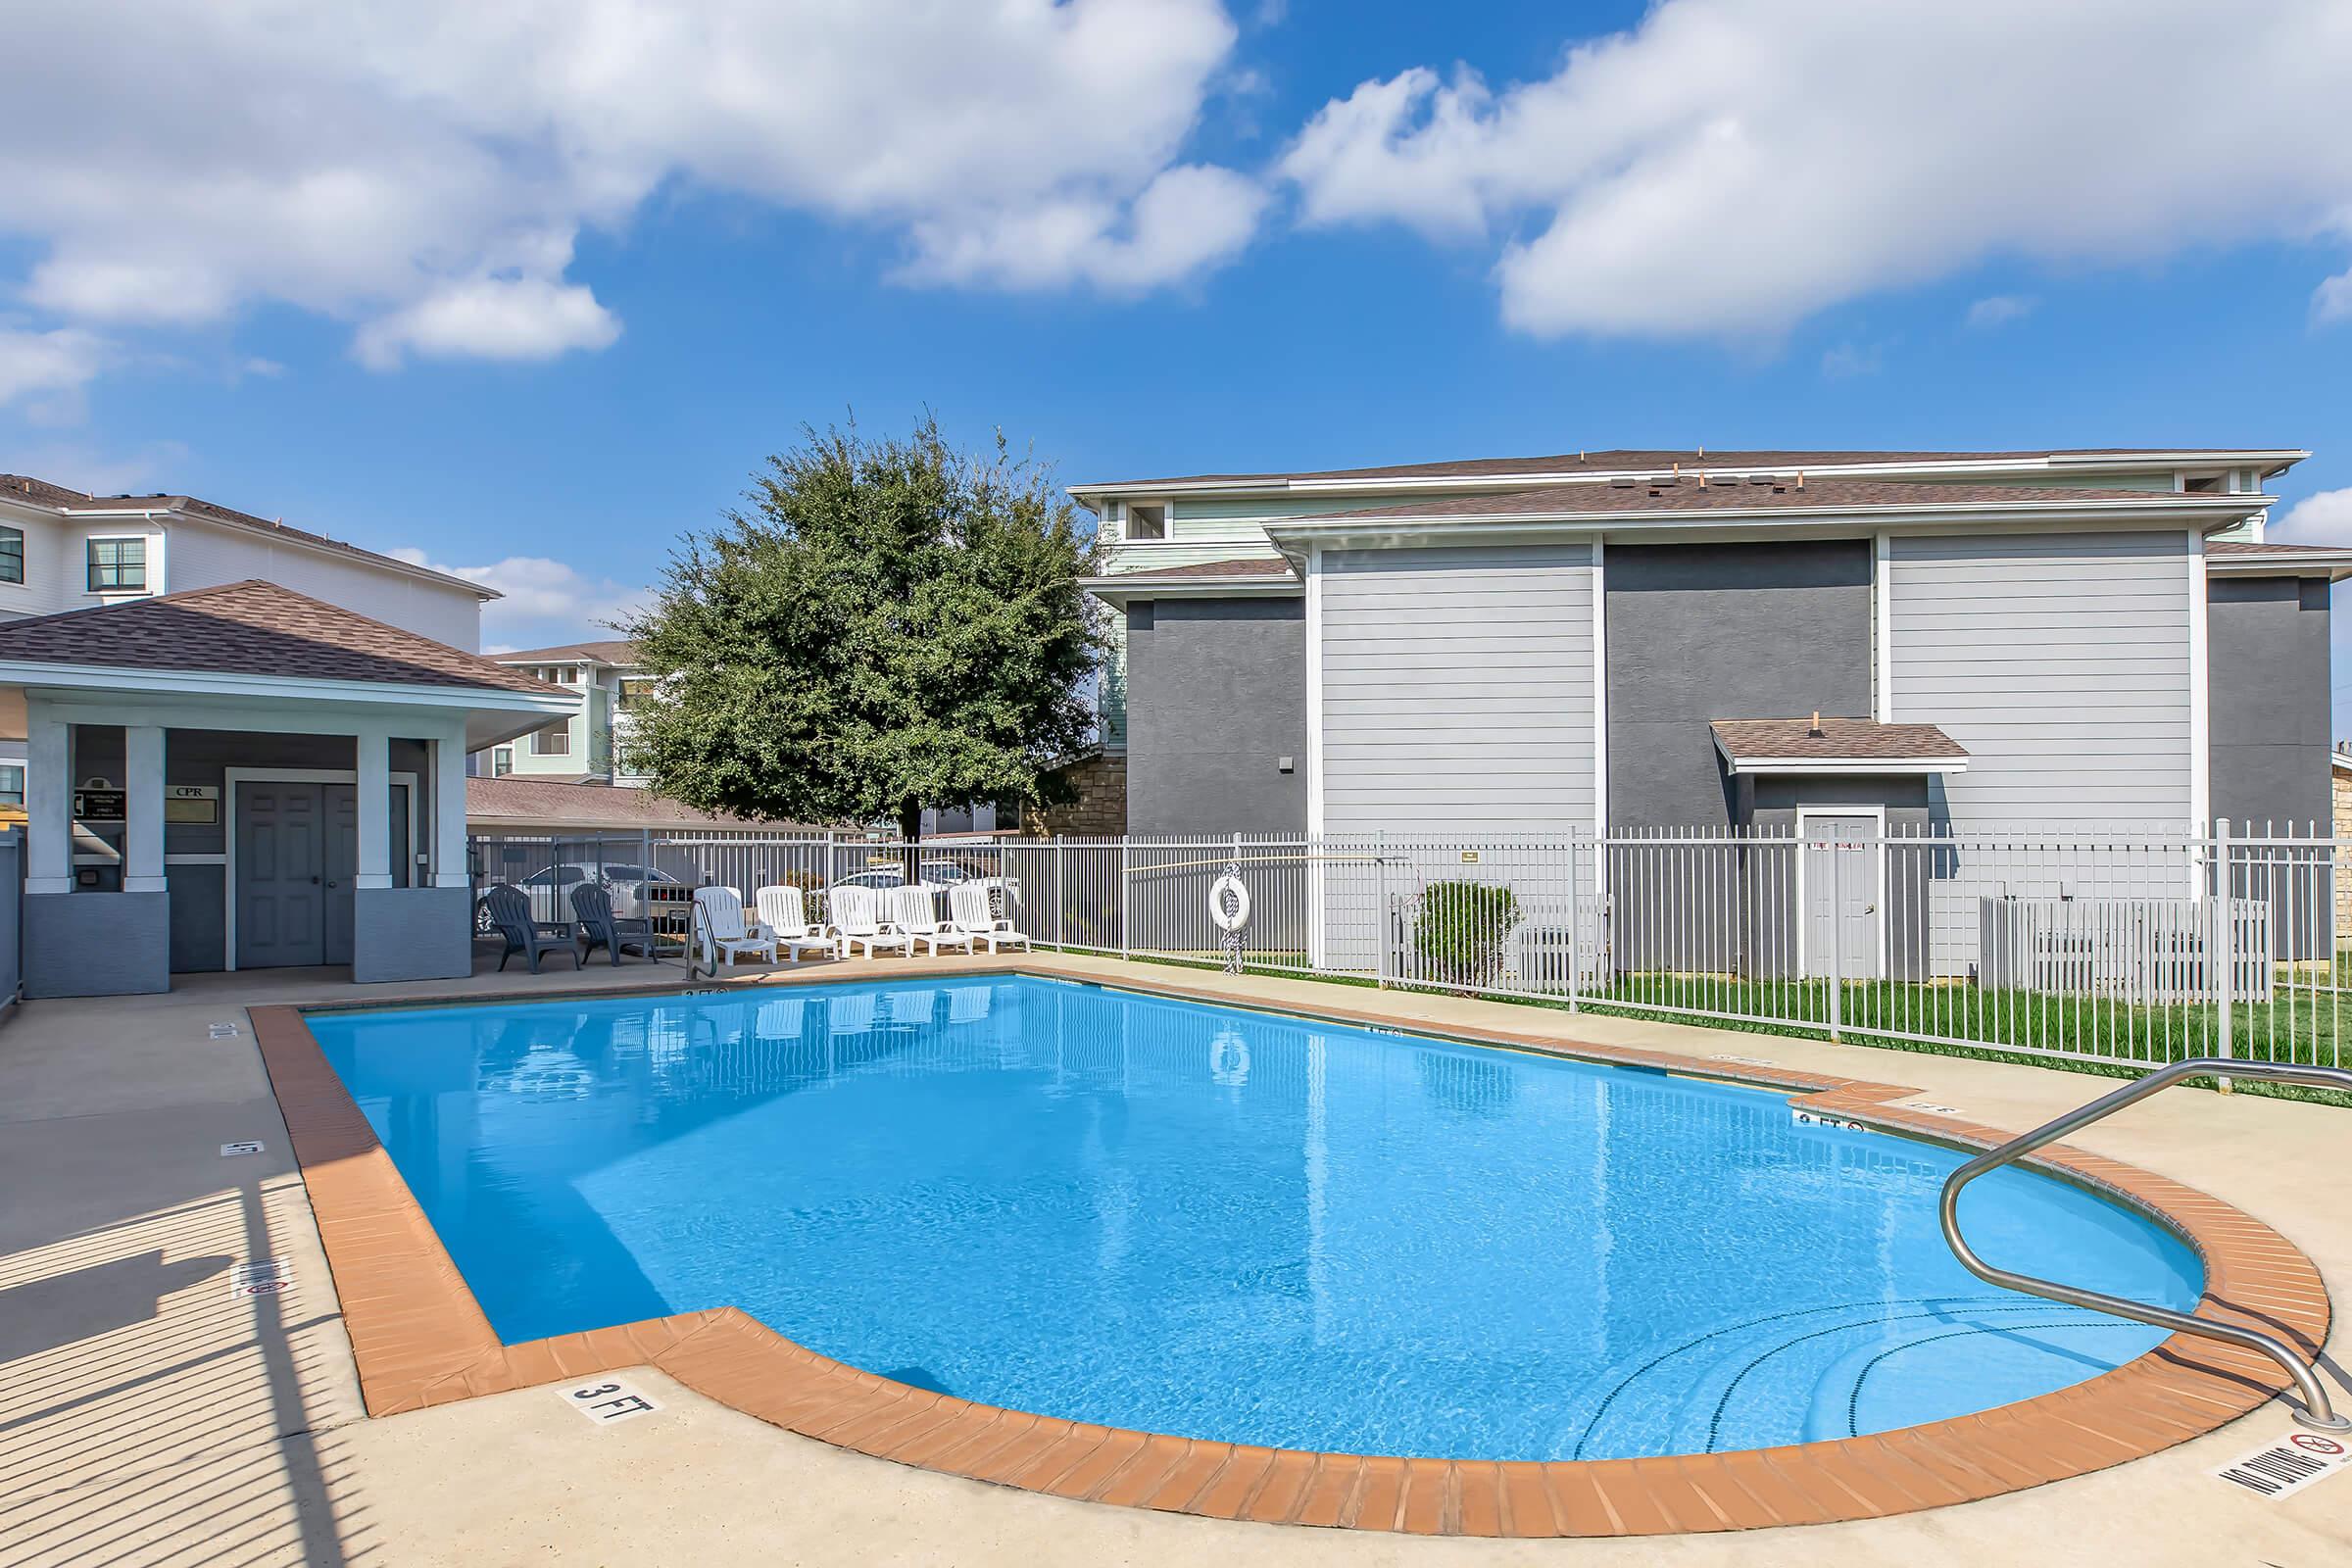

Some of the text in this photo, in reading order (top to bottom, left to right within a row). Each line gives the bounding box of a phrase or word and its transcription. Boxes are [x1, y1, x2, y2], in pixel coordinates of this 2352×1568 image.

[176, 787, 203, 797] CPR
[573, 1383, 655, 1419] 3 FT
[2218, 1446, 2329, 1495] NO DIVING
